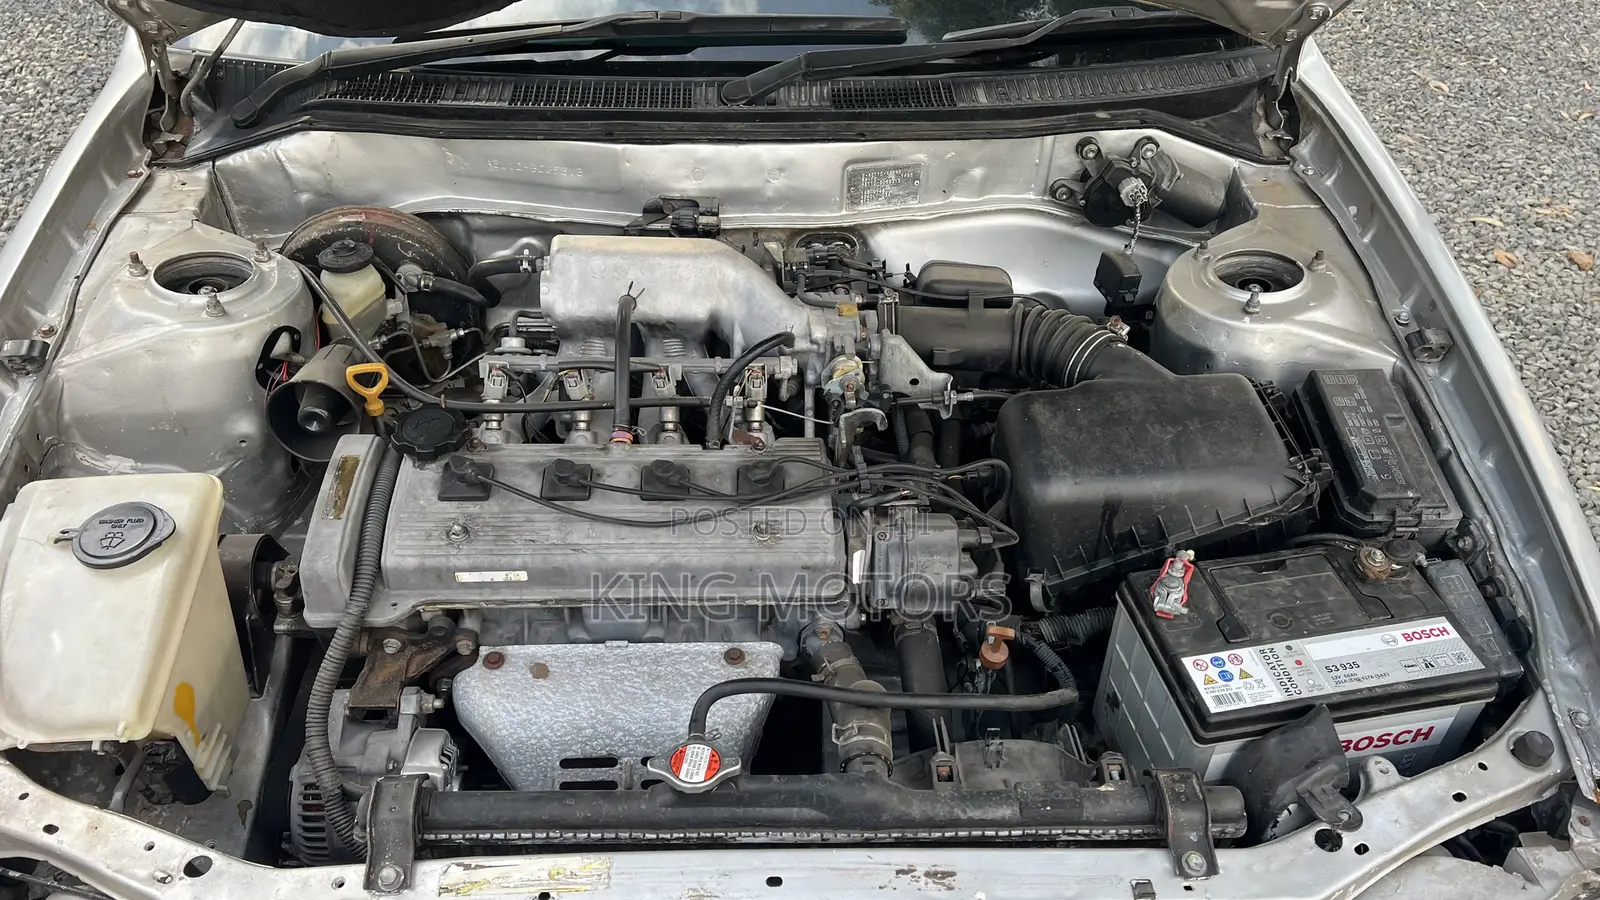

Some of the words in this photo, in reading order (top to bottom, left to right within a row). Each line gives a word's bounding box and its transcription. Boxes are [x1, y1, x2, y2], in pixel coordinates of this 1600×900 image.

[1401, 626, 1451, 643] BOSCH
[1259, 648, 1295, 698] INDICATOR
[1267, 647, 1303, 696] CONDITION
[1324, 664, 1340, 674] S3
[1340, 660, 1361, 671] 935
